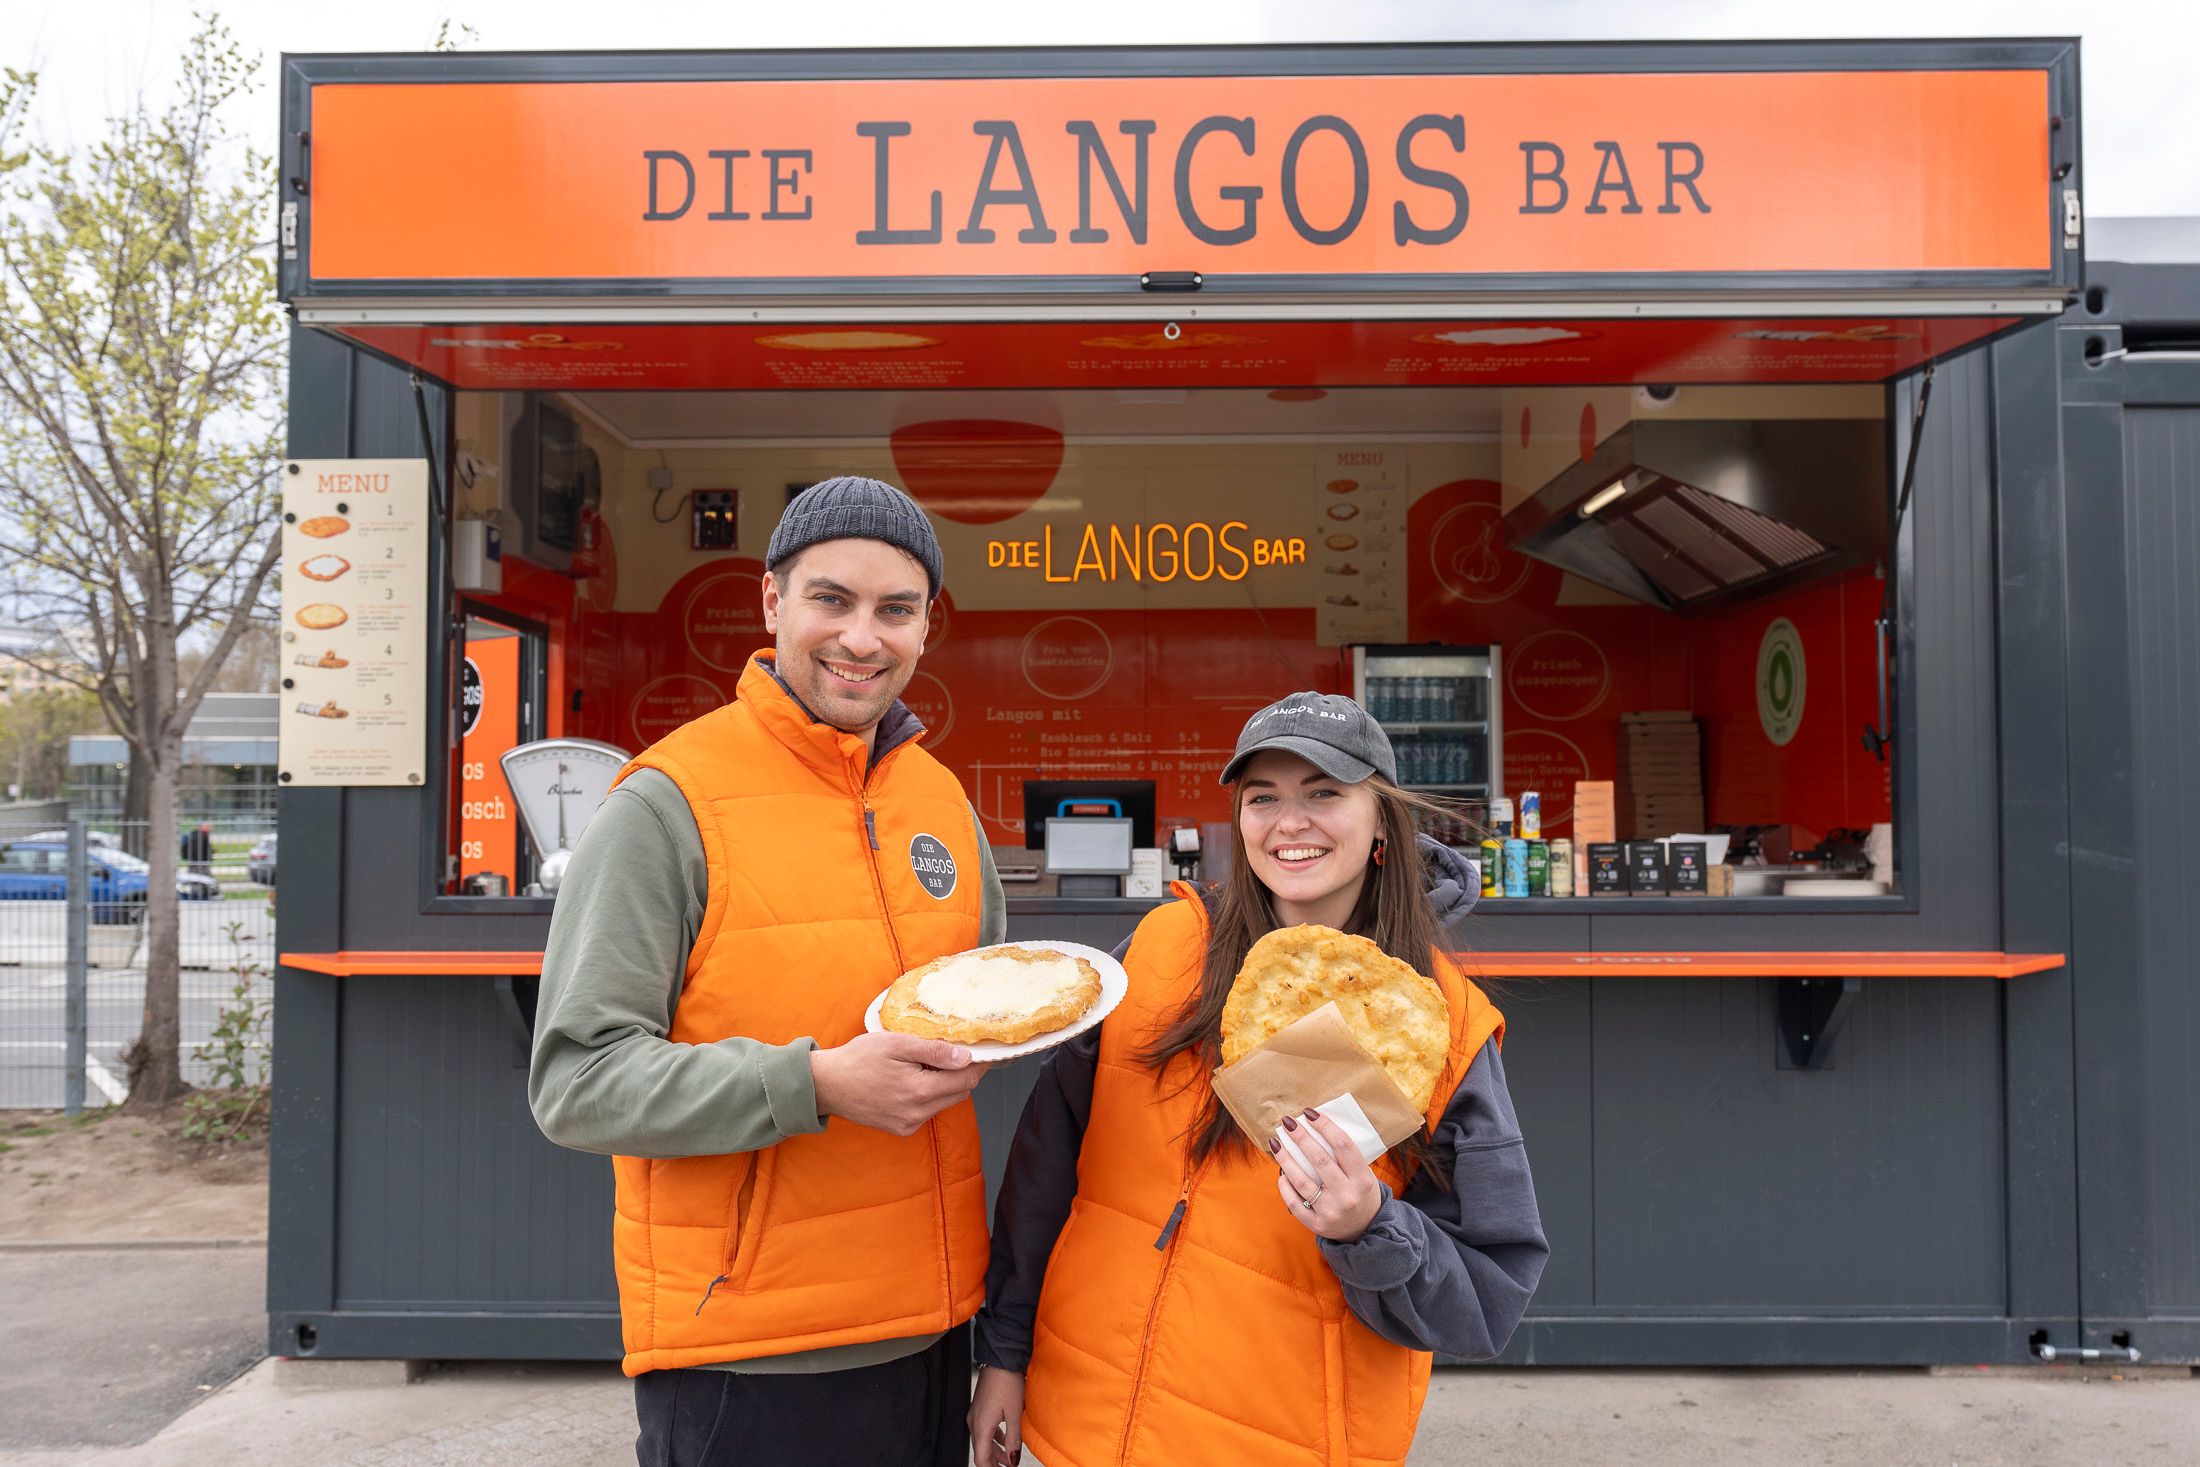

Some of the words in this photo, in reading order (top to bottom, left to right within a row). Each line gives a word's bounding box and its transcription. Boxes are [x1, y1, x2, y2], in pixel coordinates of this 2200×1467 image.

[643, 149, 814, 222] DIE
[855, 113, 1471, 250] LANGOS
[1519, 141, 1713, 216] BAR
[1336, 453, 1383, 466] MENU
[317, 474, 390, 494] MENU
[387, 504, 395, 517] 1
[385, 547, 394, 560] 2
[988, 539, 1042, 569] DIE
[1044, 521, 1250, 584] LANGOS
[1252, 537, 1307, 567] BAR
[385, 588, 394, 601] 3
[694, 623, 765, 636] Handgemac
[384, 644, 393, 656] 4
[384, 693, 393, 706] 5
[986, 708, 1044, 725] Langos
[1052, 707, 1082, 721] mit
[1269, 704, 1315, 718] ANGOS
[1319, 710, 1347, 723] BAR
[1041, 746, 1062, 758] Bio
[920, 843, 935, 853] DIE
[910, 855, 955, 875] LANGOS
[928, 877, 944, 889] BAR
